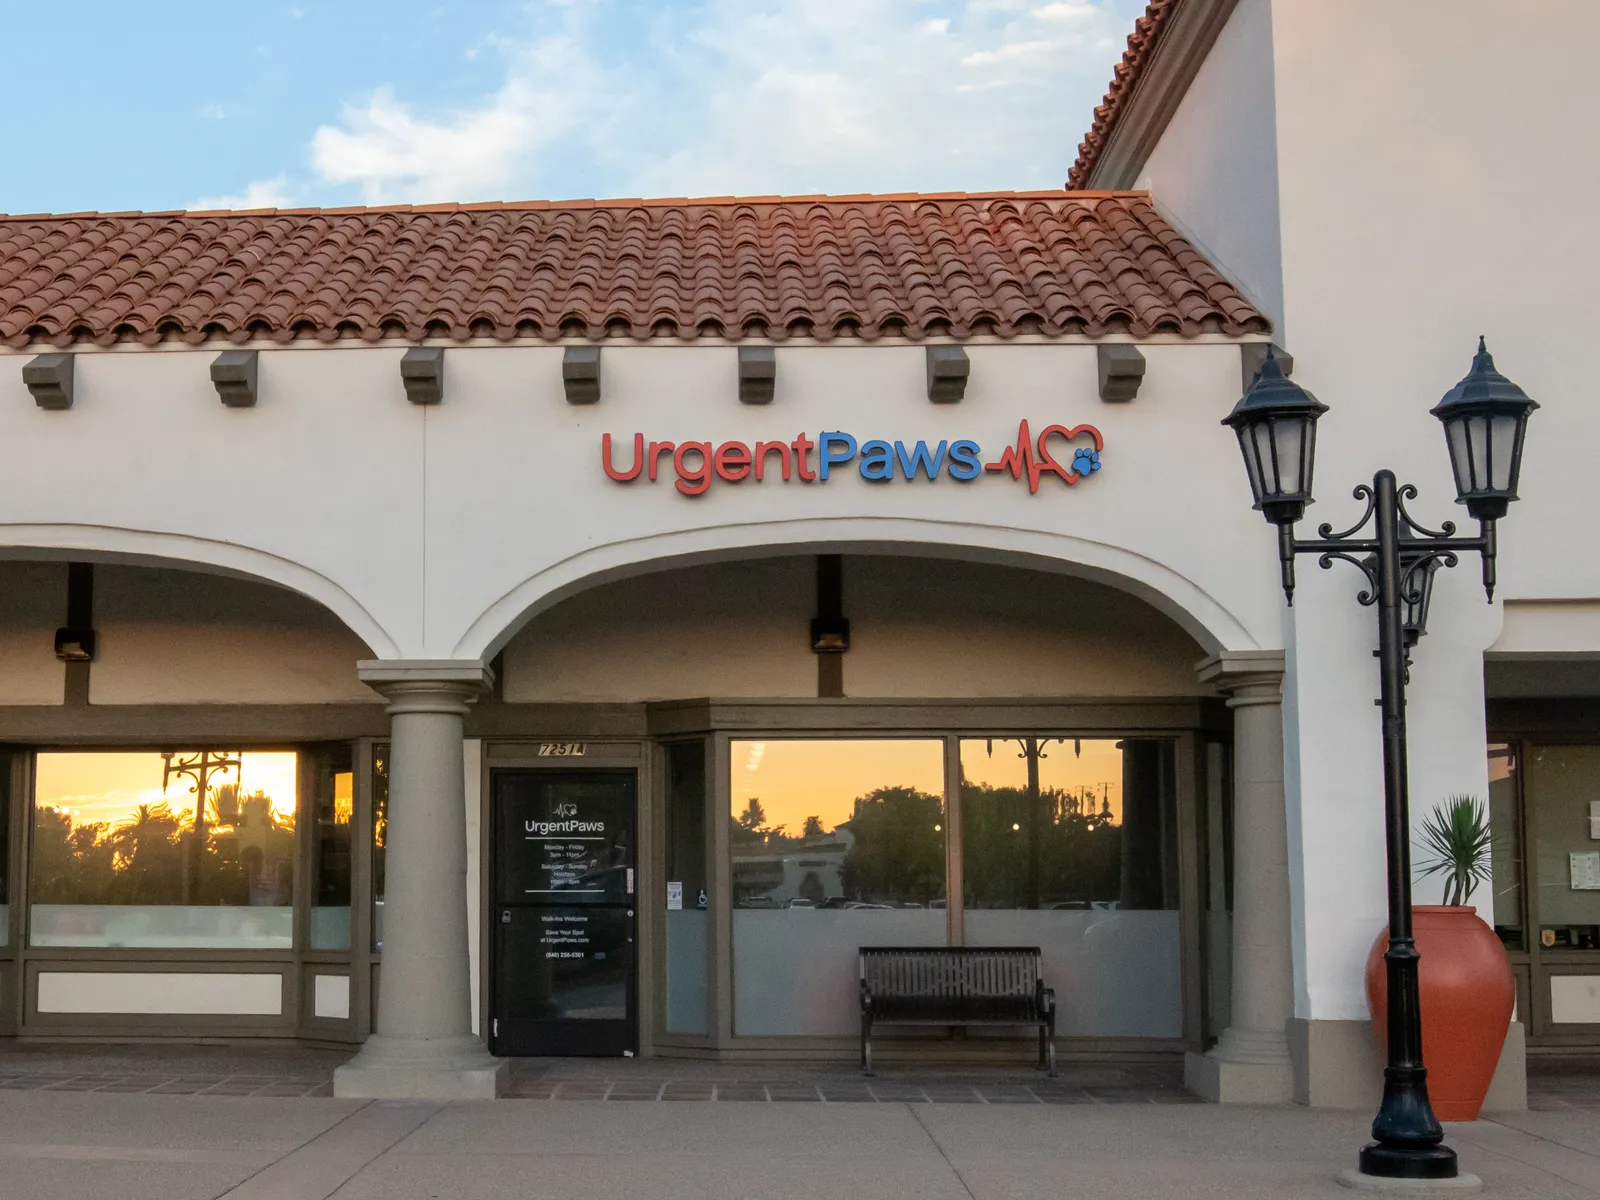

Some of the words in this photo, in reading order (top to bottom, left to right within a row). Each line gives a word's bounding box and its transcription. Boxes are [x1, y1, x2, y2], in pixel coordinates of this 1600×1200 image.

[602, 430, 981, 495] UrgentPaws
[541, 743, 584, 755] 7251A
[525, 820, 604, 835] UrgentPaws
[568, 863, 587, 871] Sunday
